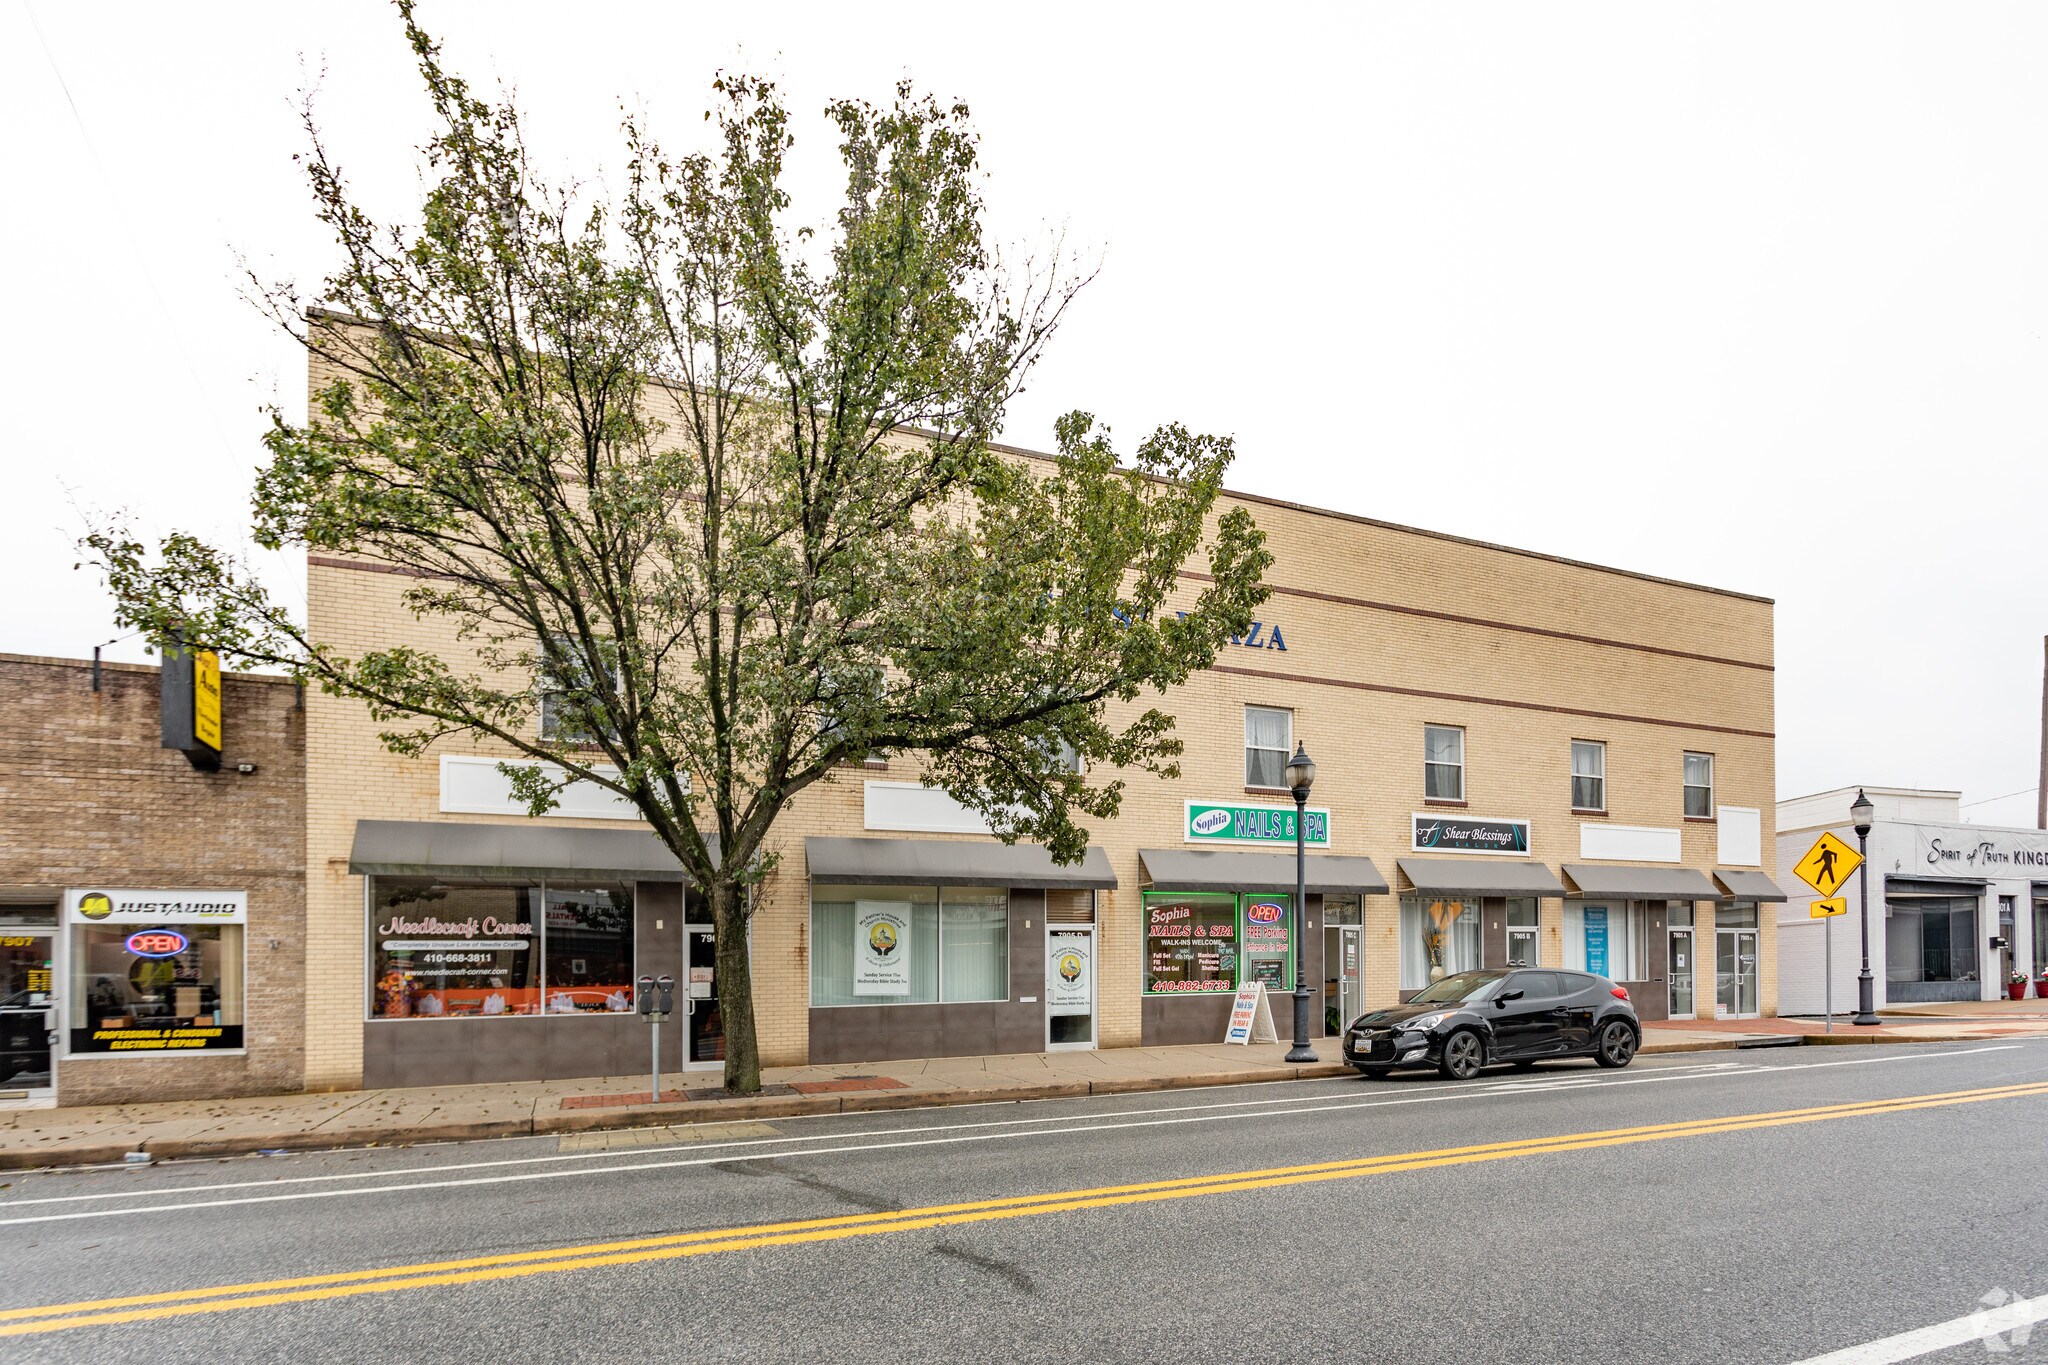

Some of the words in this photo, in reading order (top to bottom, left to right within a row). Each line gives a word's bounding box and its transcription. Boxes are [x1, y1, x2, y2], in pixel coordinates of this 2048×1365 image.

[1195, 812, 1227, 831] Sophia
[1235, 810, 1281, 838] NAILS
[1286, 816, 1294, 836] &
[1443, 825, 1471, 840] Shear
[1471, 827, 1513, 846] Blessings
[1455, 841, 1498, 849] SALON
[1966, 848, 1978, 866] of
[1151, 906, 1191, 923] Sophia
[1249, 904, 1280, 922] OPEN
[378, 916, 480, 938] Needlecraft
[482, 916, 533, 935] Corner
[1149, 925, 1191, 937] NAILS
[1195, 925, 1206, 937] &
[1209, 925, 1233, 937] SPA
[1247, 926, 1261, 938] FREE
[1263, 926, 1288, 941] Parking
[129, 935, 182, 952] OPEN
[1246, 942, 1268, 952] Entrance
[1276, 942, 1289, 952] Rear
[423, 953, 492, 963] 410-668-3811
[404, 968, 508, 976] www.needlecraft-corner.com
[1152, 980, 1230, 992] 410-882-6733
[93, 1030, 162, 1040] PROFESSIONAL
[162, 1029, 171, 1038] &
[172, 1028, 222, 1038] CONSUMER
[109, 1040, 167, 1049] ELECTRONIC
[166, 1039, 207, 1048] REPAIRS
